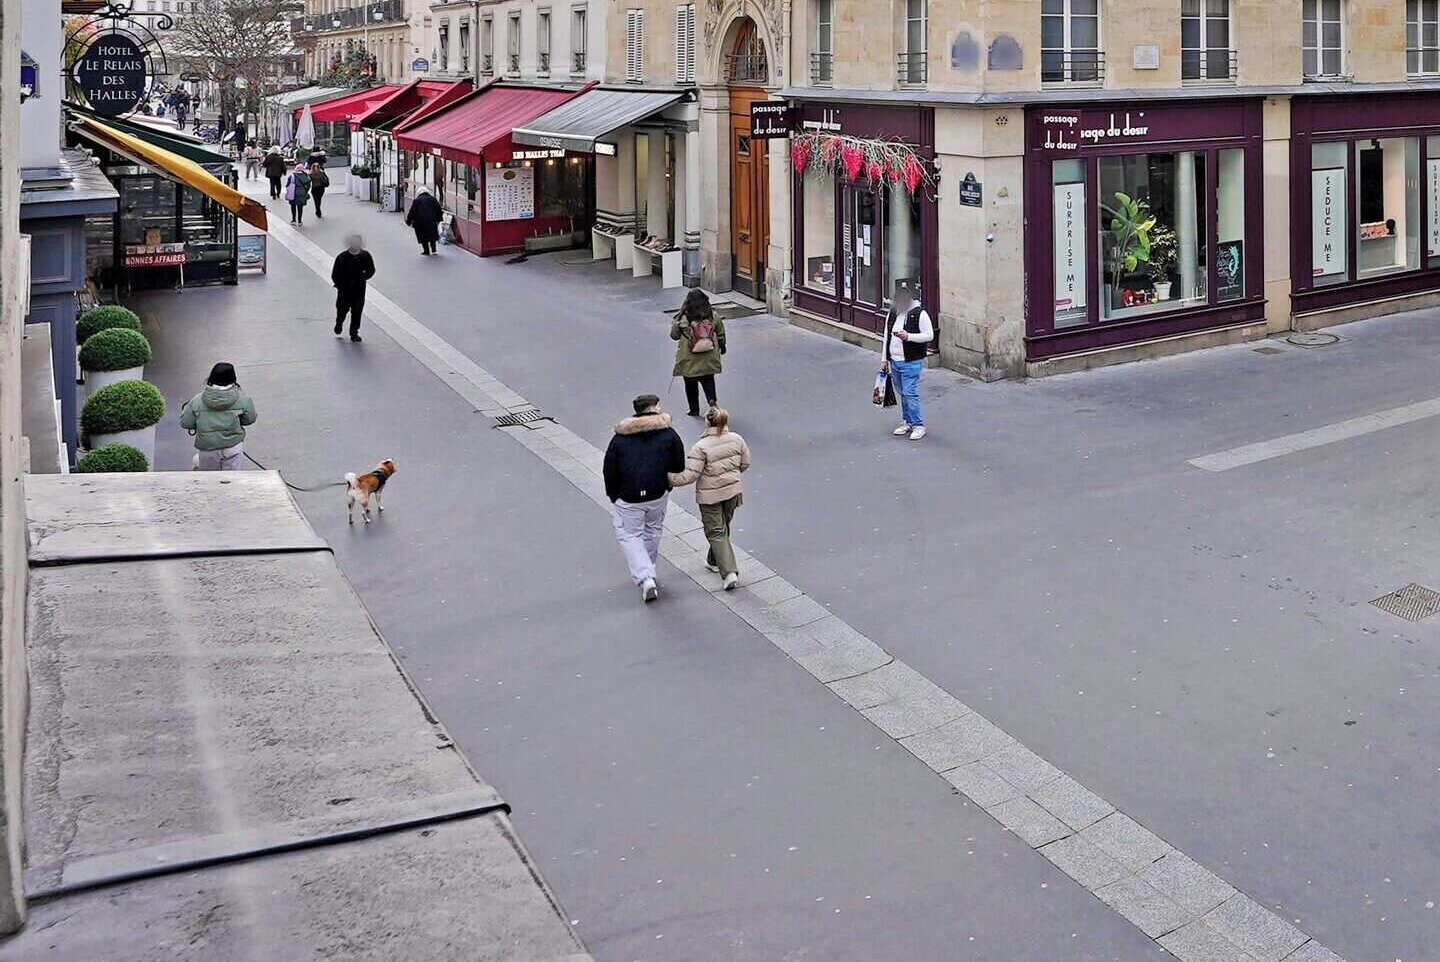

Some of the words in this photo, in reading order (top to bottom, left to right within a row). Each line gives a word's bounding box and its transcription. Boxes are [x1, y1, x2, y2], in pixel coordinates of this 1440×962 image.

[98, 46, 133, 56] HÔTEL
[86, 60, 99, 70] LE
[104, 60, 142, 71] RELAIS
[103, 75, 125, 85] DES
[90, 89, 137, 100] HALLES
[752, 105, 787, 115] passage
[753, 118, 764, 134] du
[1043, 115, 1078, 127] passage
[1107, 113, 1121, 136] du
[1044, 130, 1055, 149] du
[1433, 230, 1440, 245] ME
[1324, 243, 1332, 262] ME
[125, 255, 153, 266] BONNES
[154, 253, 186, 264] AFFAIRES
[1066, 274, 1075, 292] ME
